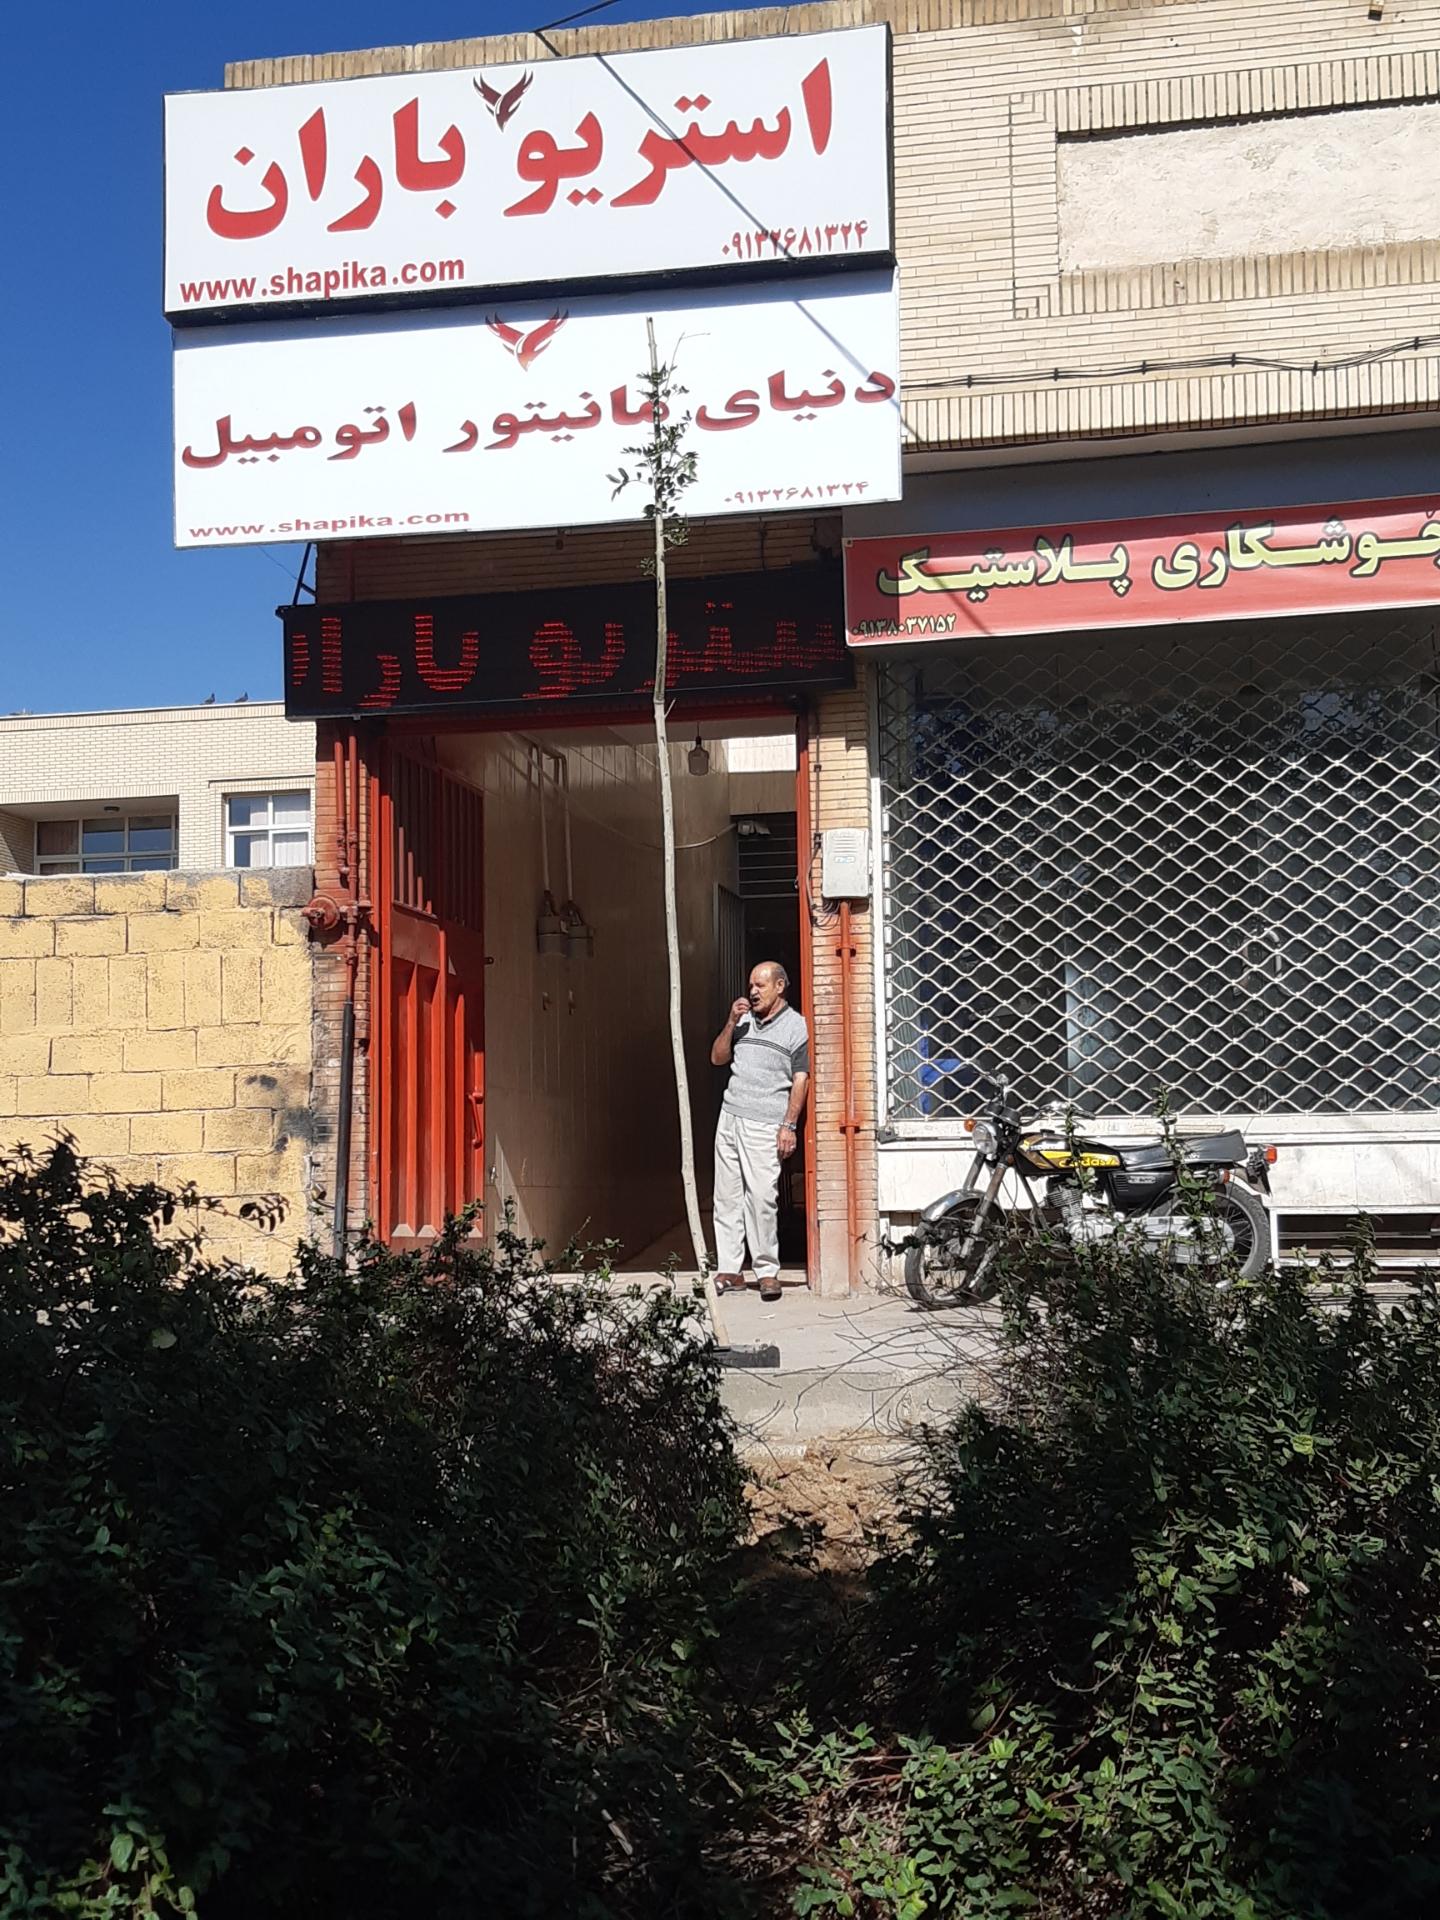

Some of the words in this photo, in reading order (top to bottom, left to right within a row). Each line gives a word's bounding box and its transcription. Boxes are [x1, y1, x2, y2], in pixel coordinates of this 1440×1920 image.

[206, 97, 466, 240] باران
[502, 57, 833, 217] استریو
[721, 219, 869, 260] ۰۹۱۳۲۶۸۱۳۲۴
[441, 384, 671, 453] مانیتور
[695, 368, 897, 432] دنیای
[181, 401, 418, 470] اتومبیل
[724, 480, 870, 504] ۰۹۱۳۲۶۸۱۳۲۴
[877, 533, 1133, 603] پلاستیک
